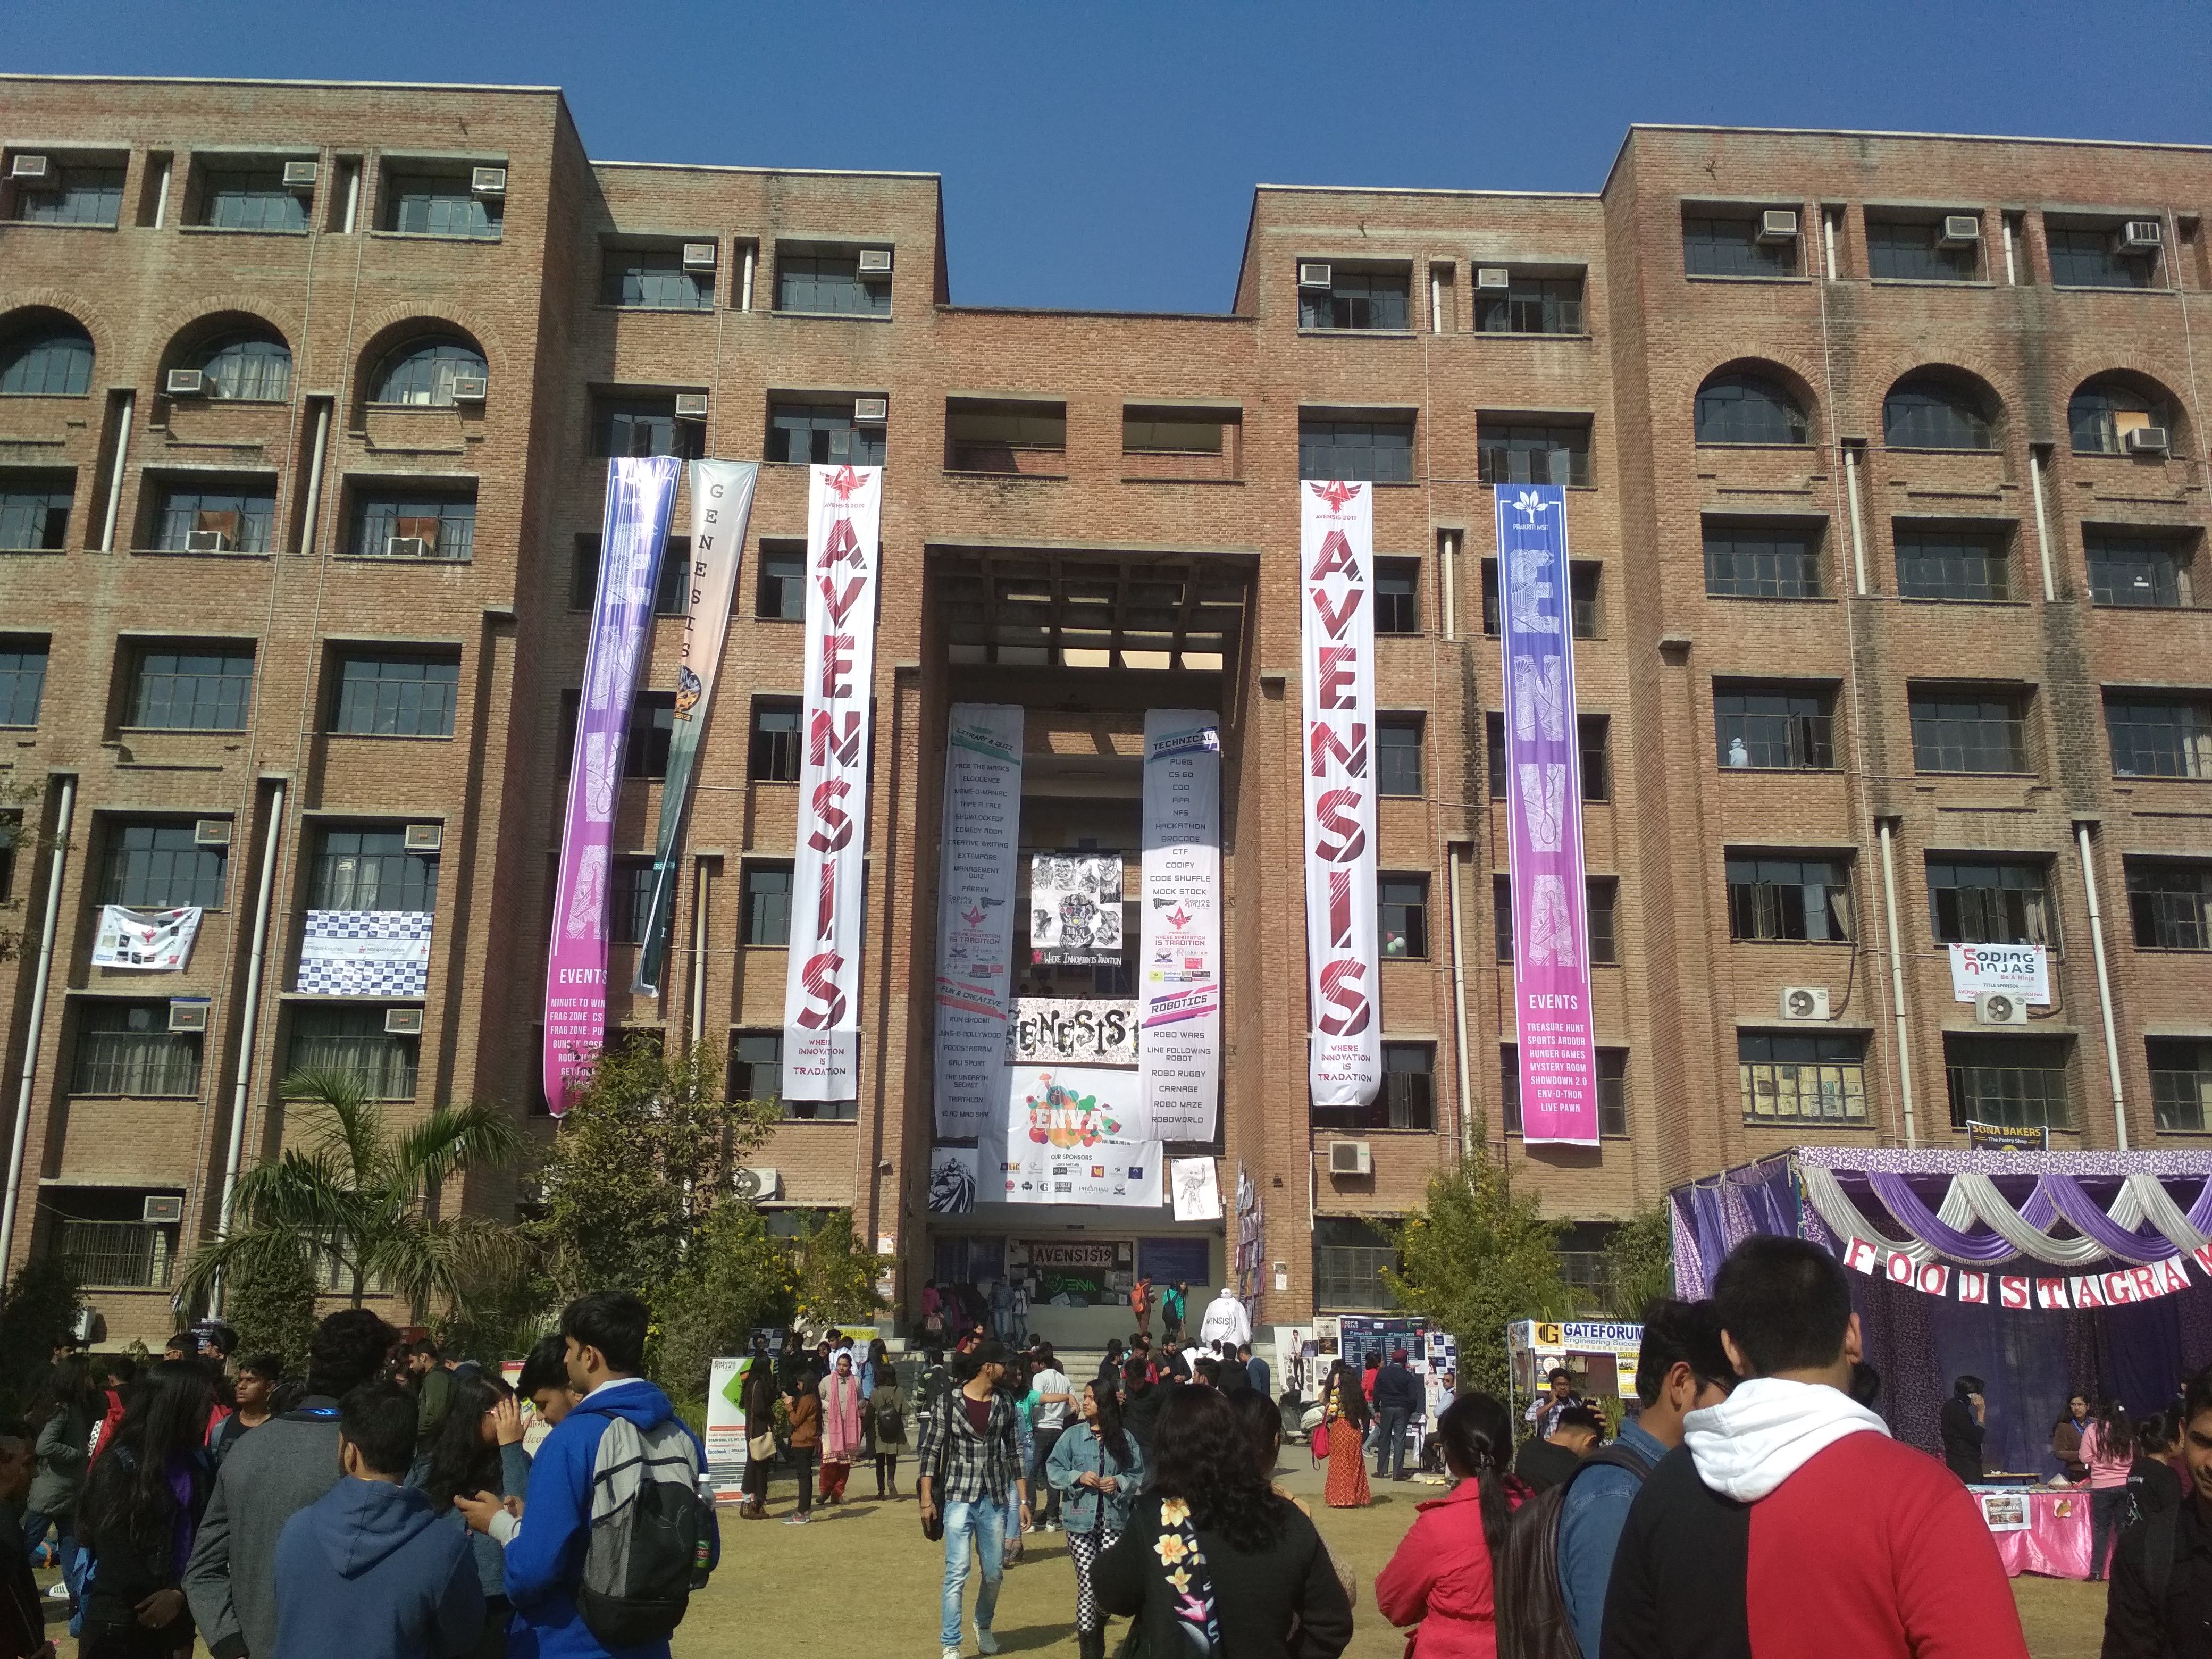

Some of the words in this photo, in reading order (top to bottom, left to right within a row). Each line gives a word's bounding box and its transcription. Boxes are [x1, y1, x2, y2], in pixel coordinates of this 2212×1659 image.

[681, 484, 724, 658] GENESIS
[957, 727, 987, 741] LITRARY
[995, 741, 1013, 751] QUIZ
[1153, 734, 1212, 750] TECHNICAL
[1509, 549, 1578, 967] ENVA
[796, 517, 868, 1030] AVENSIS
[1309, 529, 1370, 1036] AVENSIS
[1044, 952, 1061, 963] WHERE
[1096, 953, 1122, 965] TRADITION
[1963, 948, 2034, 963] CODING
[1965, 962, 2034, 975] NINJAS
[559, 968, 607, 985] EVENTS
[941, 985, 955, 995] FUN
[963, 992, 1003, 1007] CREATIVE
[1529, 994, 1578, 1010] EVENTS
[551, 998, 577, 1007] MINUTE
[579, 998, 588, 1007] TO
[591, 999, 606, 1008] WIN
[1152, 995, 1208, 1013] ROBOTICS
[550, 1012, 567, 1021] FRAG
[592, 1012, 602, 1021] CS
[550, 1026, 568, 1035] FRAG
[1527, 1023, 1563, 1032] TREASURE
[1566, 1024, 1584, 1033] HUNT
[553, 1040, 571, 1049] GUNS
[1527, 1036, 1556, 1045] SPORTS
[1557, 1036, 1585, 1046] ARDOUR
[1529, 1049, 1559, 1058] HUNGER
[1561, 1050, 1585, 1059] GAMES
[793, 1067, 846, 1076] TRADATION
[1530, 1062, 1564, 1071] MYSTERY
[1566, 1063, 1586, 1073] ROOM
[1317, 1073, 1372, 1083] TRADATION
[1531, 1076, 1573, 1085] SHOWDOWN
[1576, 1077, 1587, 1086] 2.0
[1537, 1089, 1582, 1099] ENV-O-THON
[1541, 1103, 1558, 1112] LIVE
[1560, 1103, 1580, 1112] PAWN
[1035, 1108, 1104, 1130] ENVA
[1972, 1125, 2001, 1135] SONA
[2002, 1127, 2041, 1137] BAKERS
[1538, 1324, 1559, 1344] G
[1564, 1323, 1644, 1340] GATEFORUM
[524, 1434, 546, 1444] elco
